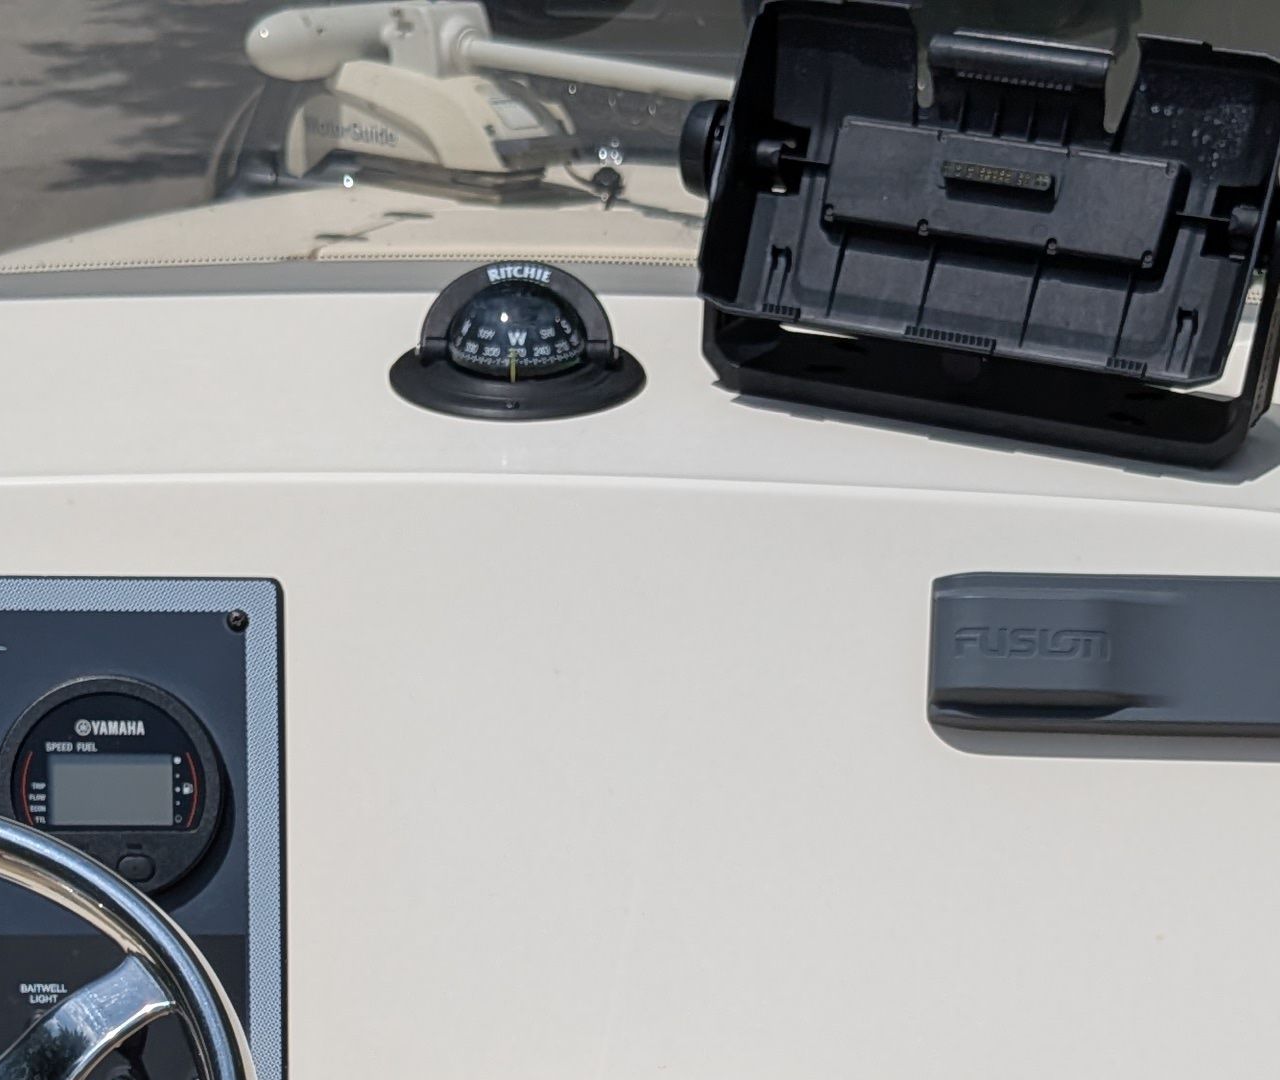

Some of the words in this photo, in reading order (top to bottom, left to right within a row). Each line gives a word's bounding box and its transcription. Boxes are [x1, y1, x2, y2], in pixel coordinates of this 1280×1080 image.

[487, 266, 552, 282] RITCHIE
[508, 331, 527, 346] W
[954, 626, 1111, 660] FUSION
[91, 721, 145, 736] YAMAHA
[46, 742, 73, 752] SPEED
[77, 742, 98, 752] FUEL
[20, 984, 67, 993] BAITWELL
[29, 995, 57, 1003] LIGHT
